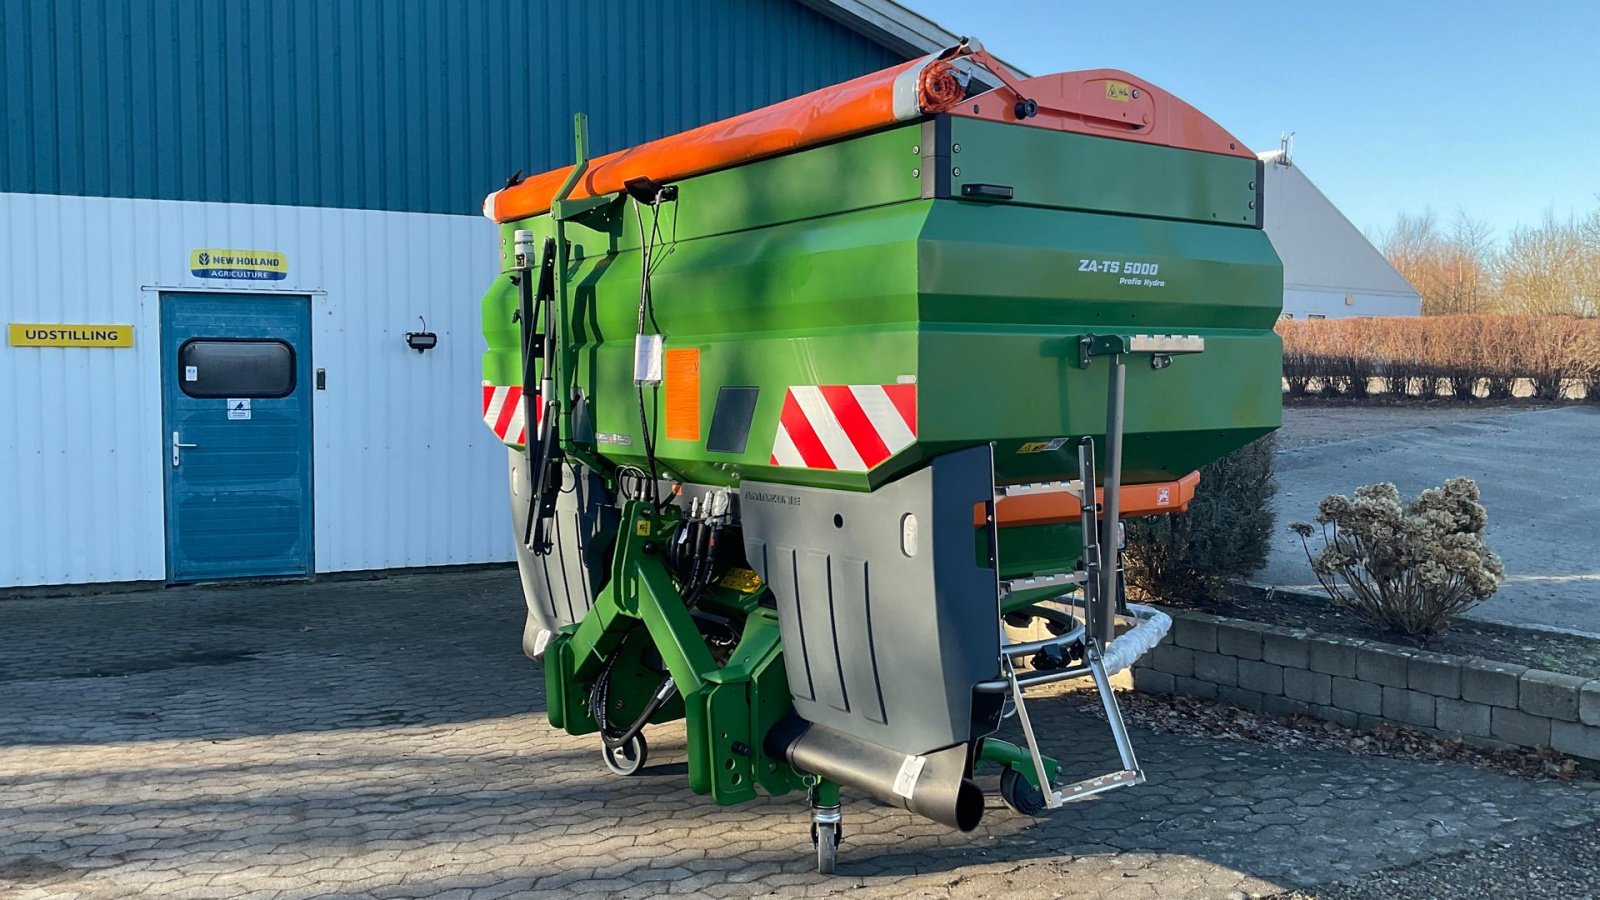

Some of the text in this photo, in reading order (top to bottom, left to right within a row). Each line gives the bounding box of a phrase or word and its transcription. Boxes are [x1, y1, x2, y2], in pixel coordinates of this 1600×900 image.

[212, 256, 280, 267] NEW HOLLAND
[1078, 259, 1159, 276] ZA-TS 5000
[210, 270, 268, 279] AGRICULTURE
[1119, 277, 1165, 288] Profis Hydro
[25, 330, 118, 341] UDSTILLING
